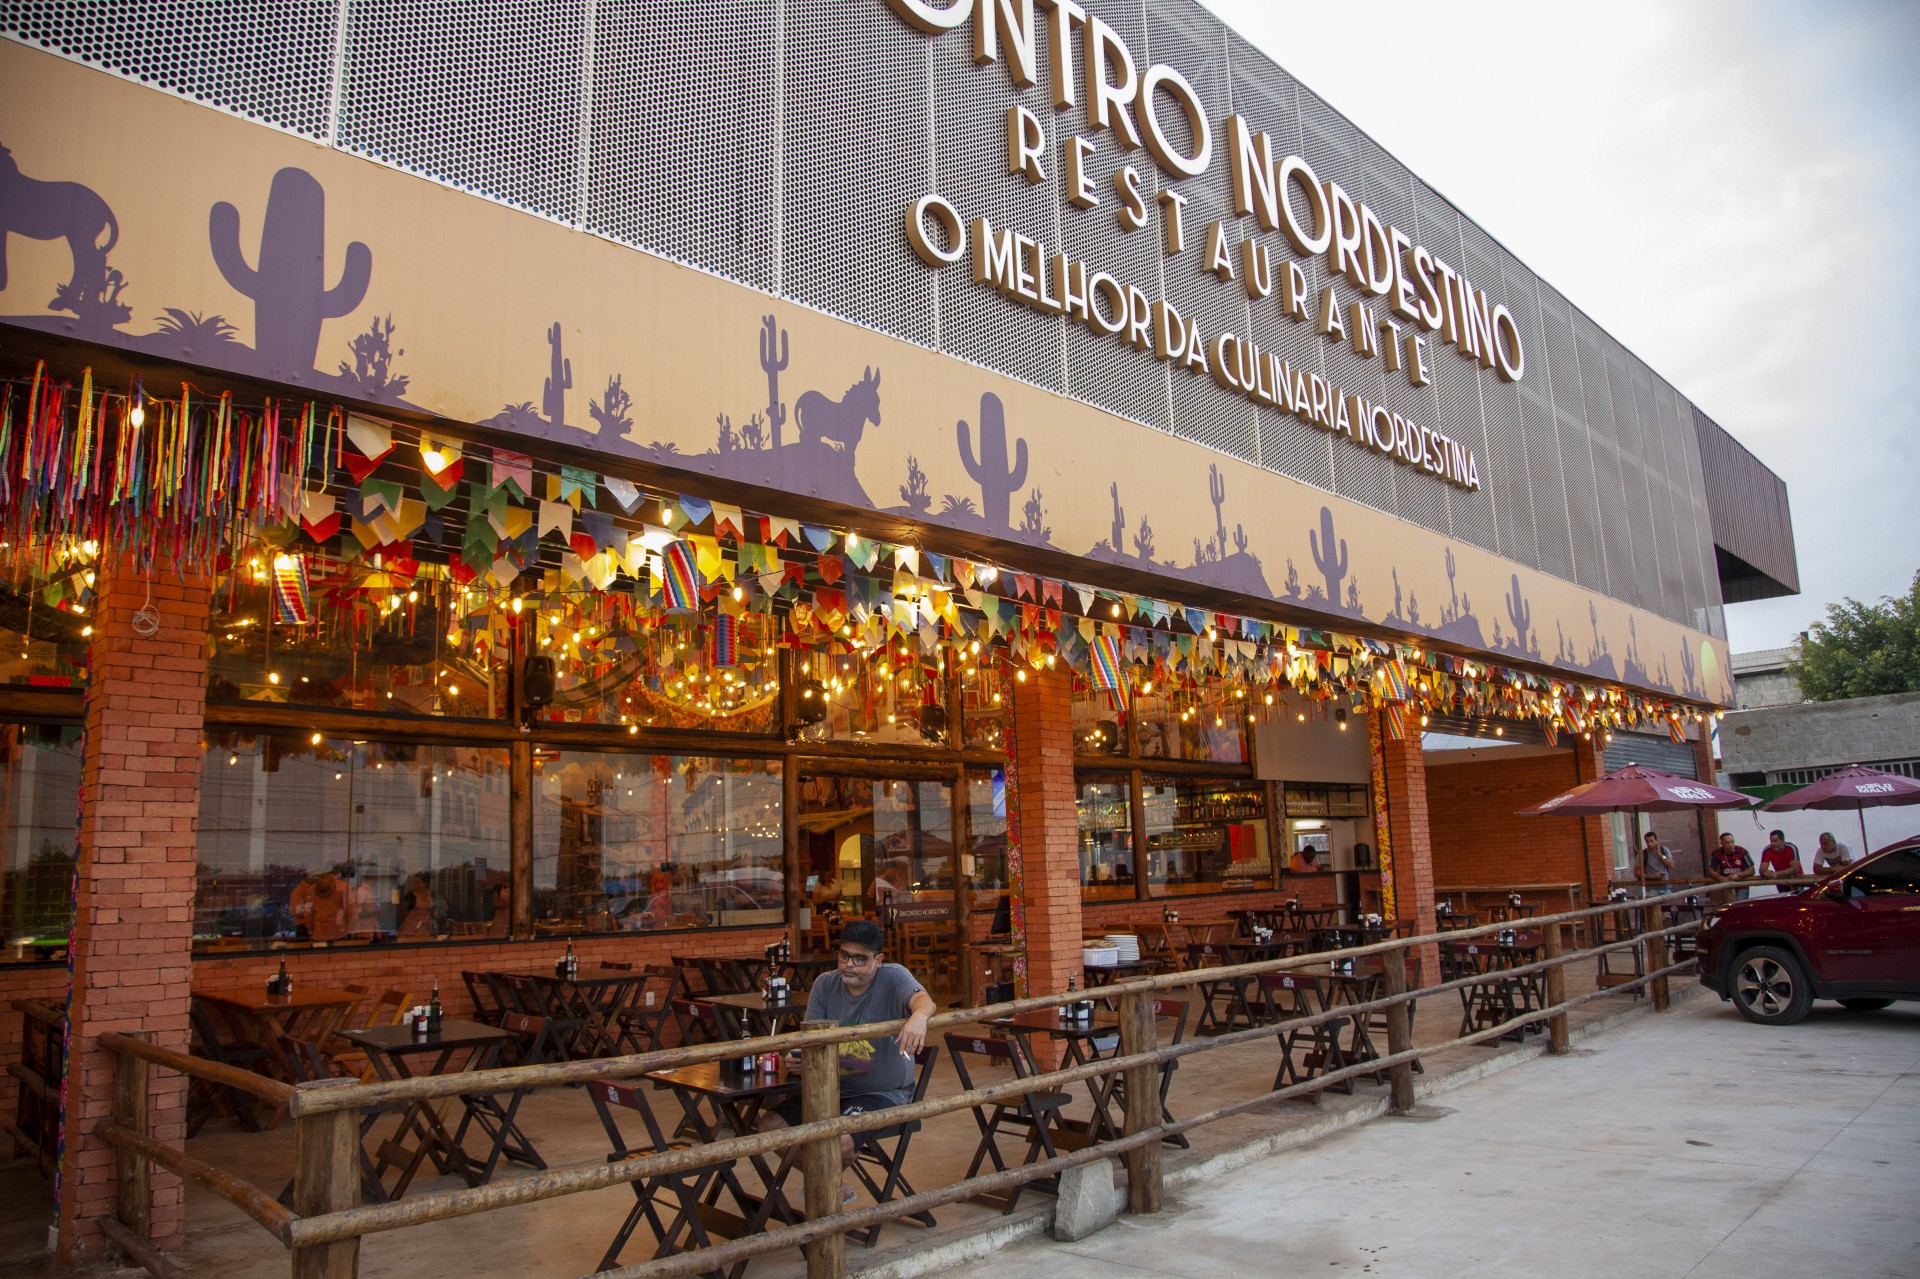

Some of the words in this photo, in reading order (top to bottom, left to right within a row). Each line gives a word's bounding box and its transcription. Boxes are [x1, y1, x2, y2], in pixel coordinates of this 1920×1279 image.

[892, 0, 1213, 178] NTRO
[1228, 113, 1525, 382] NORDESTINO
[1009, 105, 1431, 387] RESTAURANTE
[907, 194, 967, 265] O
[973, 217, 1152, 350] MELHOR
[1155, 300, 1210, 375] DA
[1210, 332, 1353, 438] CULINARIA
[1349, 394, 1481, 492] NORDESTINA
